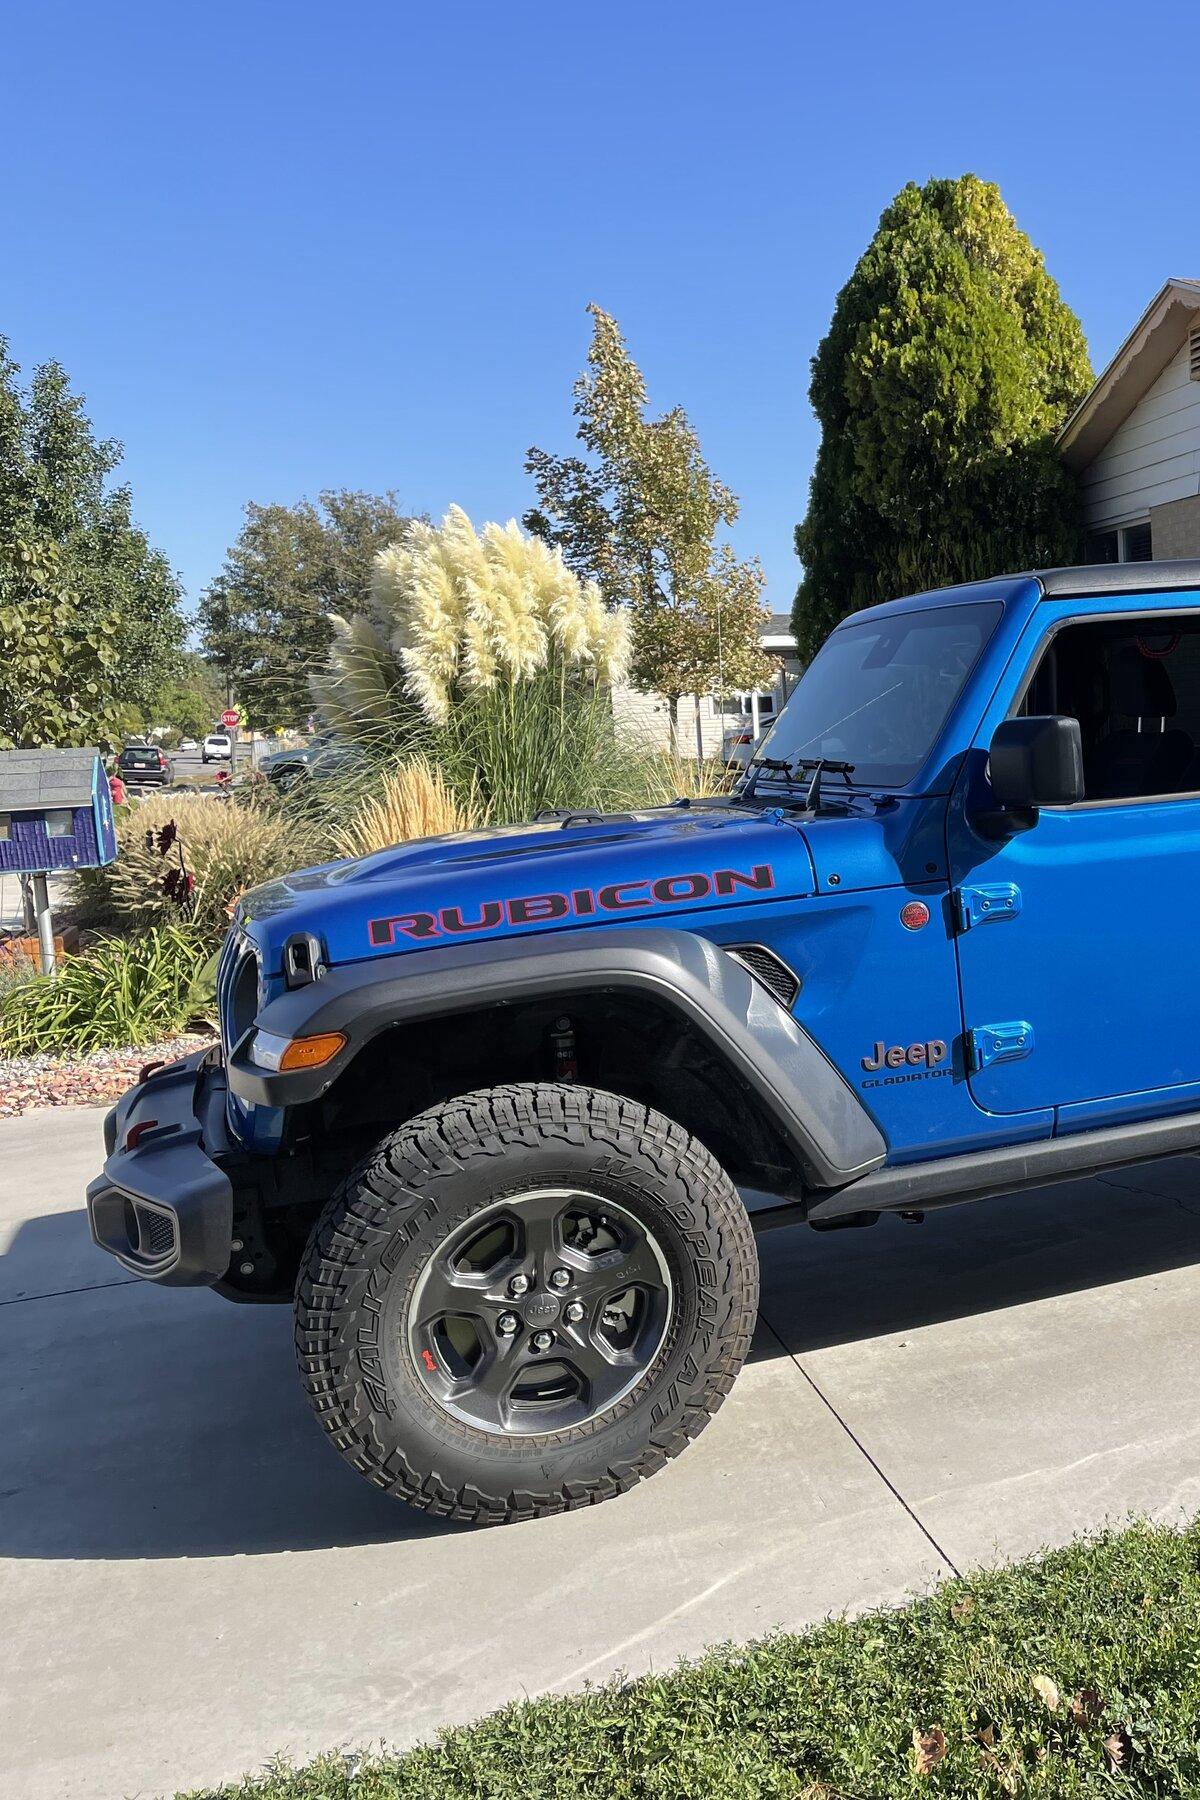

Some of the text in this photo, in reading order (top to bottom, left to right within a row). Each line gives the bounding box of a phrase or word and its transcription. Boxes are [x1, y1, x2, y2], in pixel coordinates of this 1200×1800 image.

[222, 714, 239, 722] STOP
[368, 864, 775, 946] RUBICON
[861, 1040, 947, 1072] Jeep
[861, 1068, 956, 1089] GLADIATOR
[588, 1154, 719, 1353] WILDPEAK
